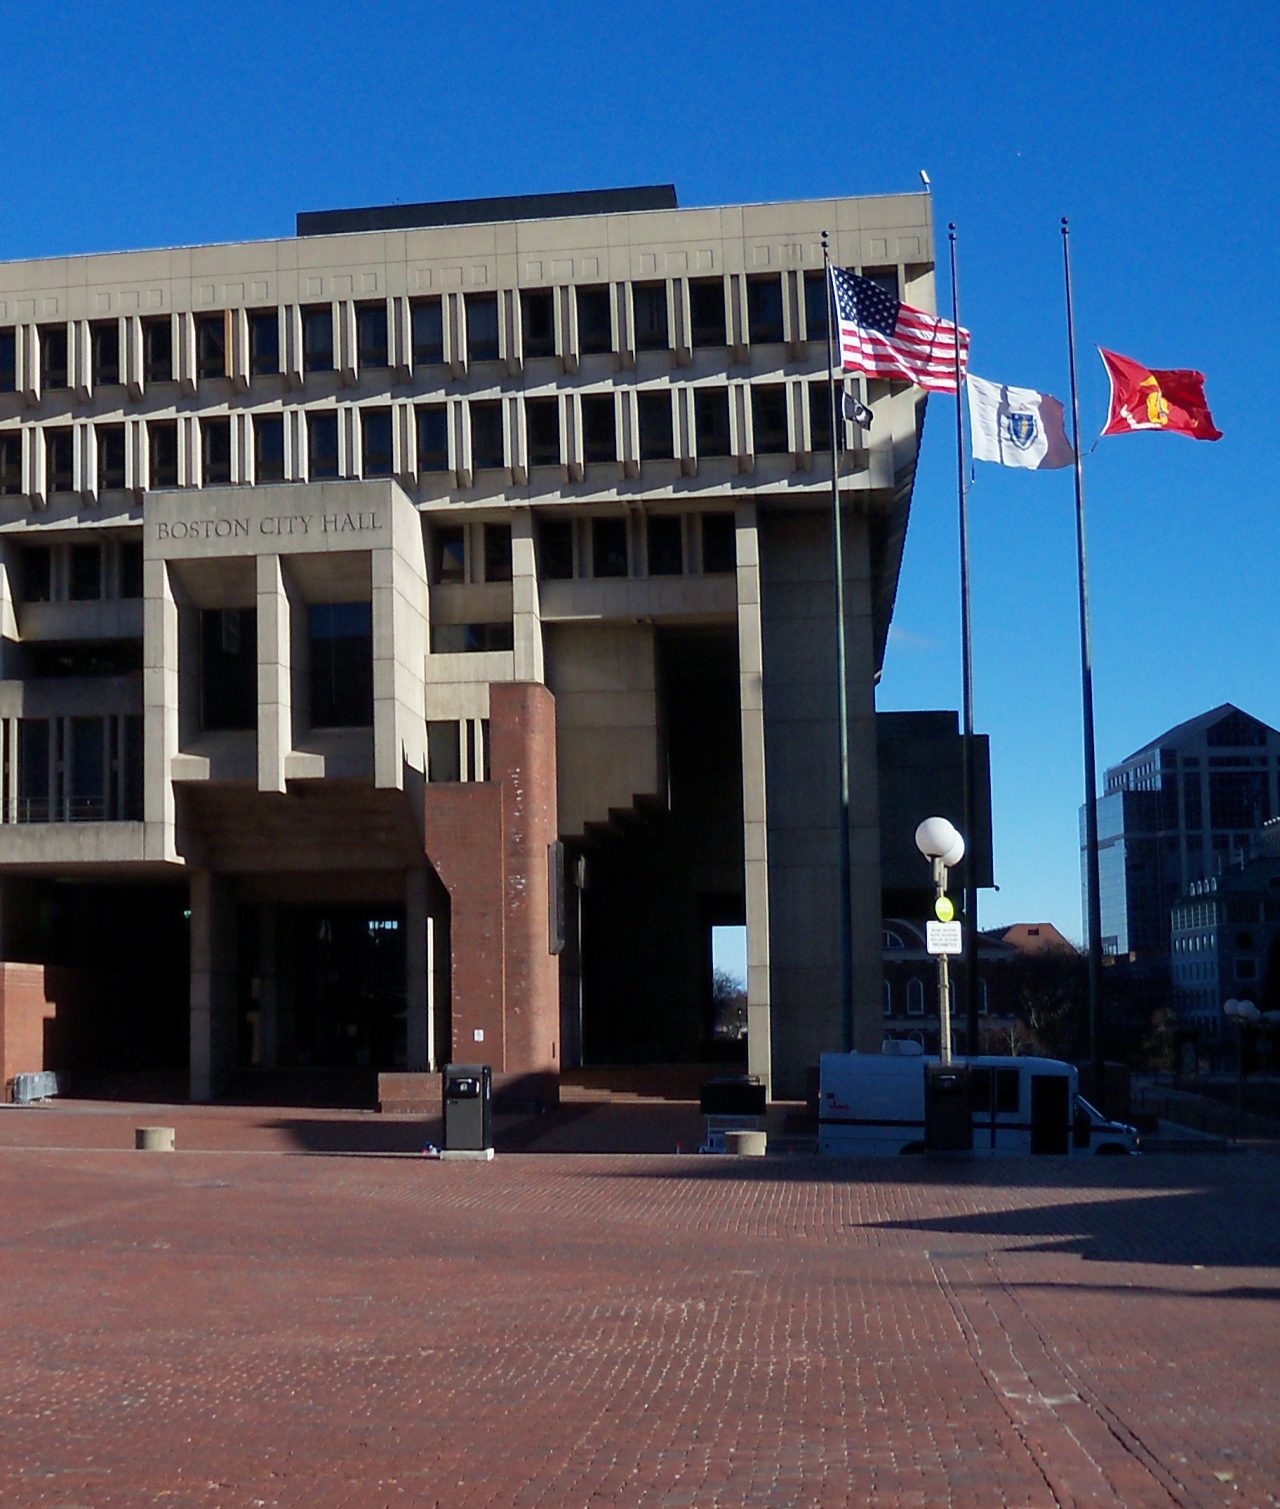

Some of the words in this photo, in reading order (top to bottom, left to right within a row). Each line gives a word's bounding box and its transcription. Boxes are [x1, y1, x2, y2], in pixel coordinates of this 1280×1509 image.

[156, 518, 250, 540] BOSTON
[259, 514, 314, 536] CITY
[321, 511, 382, 533] HALL
